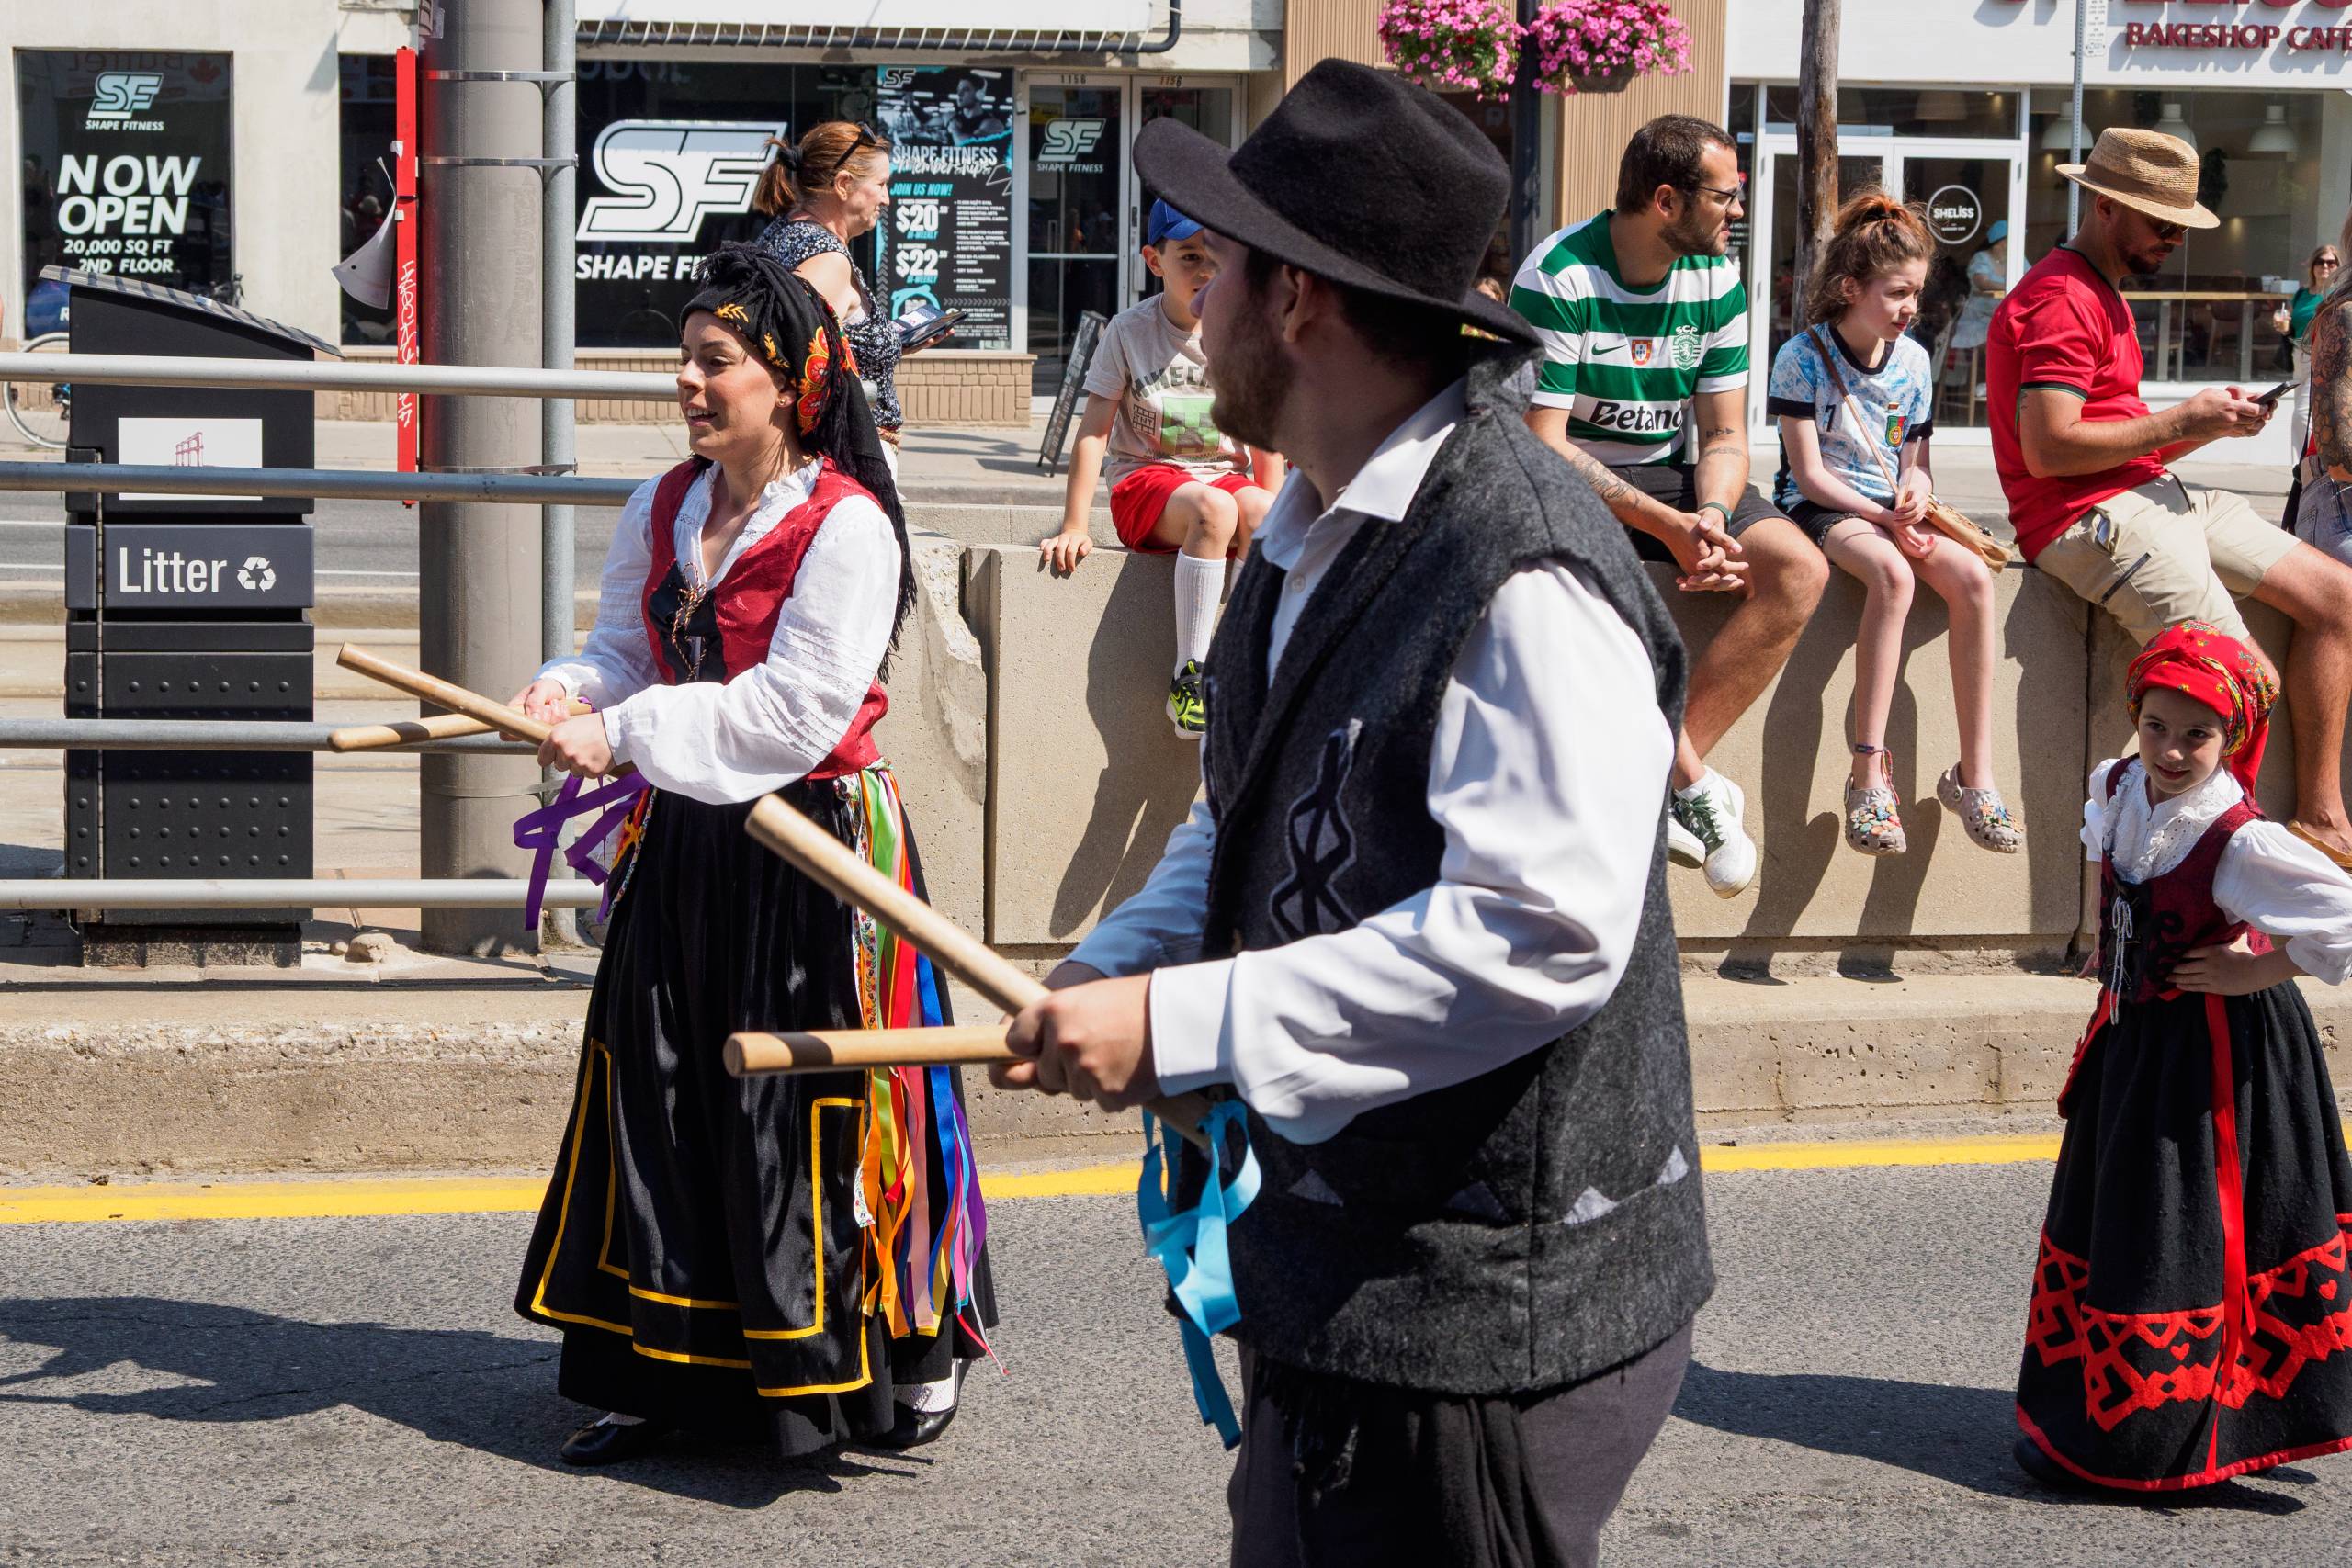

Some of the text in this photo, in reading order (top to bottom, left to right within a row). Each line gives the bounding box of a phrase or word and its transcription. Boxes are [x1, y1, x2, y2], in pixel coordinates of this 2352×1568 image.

[2126, 22, 2280, 49] BAKESHOP
[1061, 75, 1086, 84] 1156
[87, 71, 164, 118] SF
[85, 120, 164, 130] SHAPE FITNESS
[1038, 118, 1106, 162] SF
[893, 146, 997, 165] SHAPE FITNESS
[1037, 164, 1103, 172] SHAPE FITNESS
[57, 154, 202, 197] NOW
[576, 118, 788, 242] SF
[890, 182, 953, 196] JOIN US NOW!
[58, 196, 189, 235] OPEN
[63, 239, 173, 256] 20,000 SQ FT
[79, 259, 173, 273] 2ND FLOOR
[575, 254, 671, 279] SHAPE
[1676, 324, 1698, 334] SCP
[1825, 404, 1837, 432] 7
[119, 547, 227, 592] Litter
